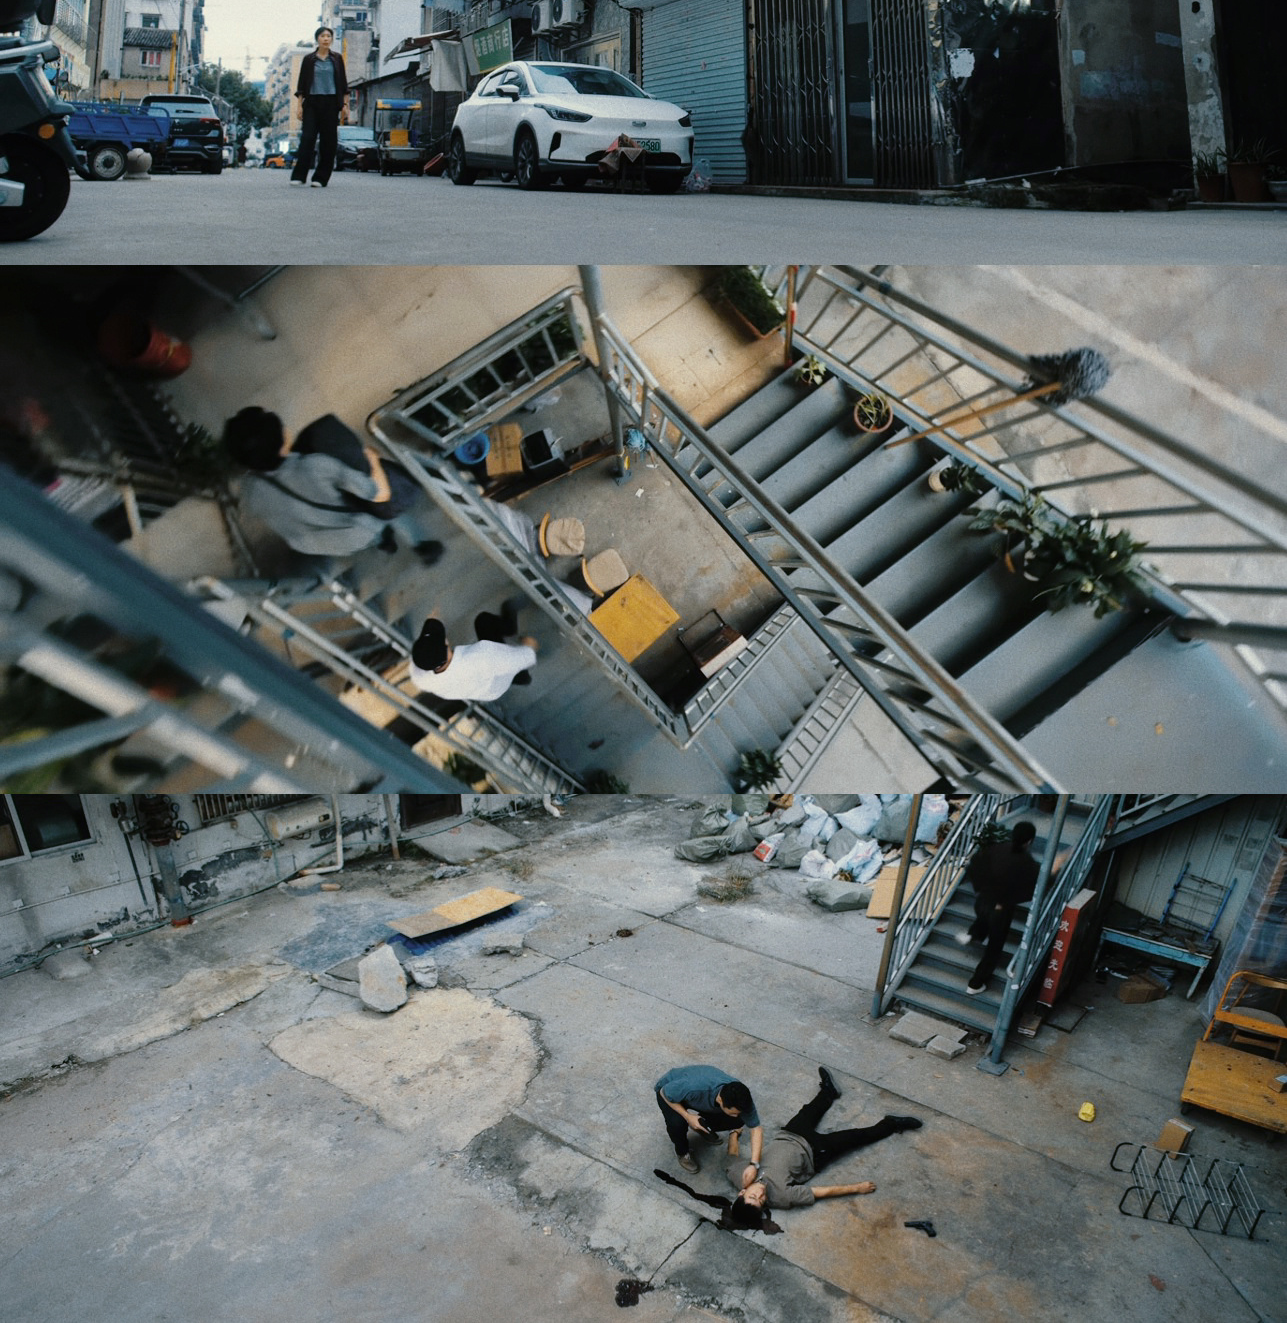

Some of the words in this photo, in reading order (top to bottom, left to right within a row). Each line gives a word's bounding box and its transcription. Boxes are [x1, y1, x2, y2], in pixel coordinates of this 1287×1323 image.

[636, 139, 660, 152] 2580
[1042, 919, 1070, 990] 欢迎光临
